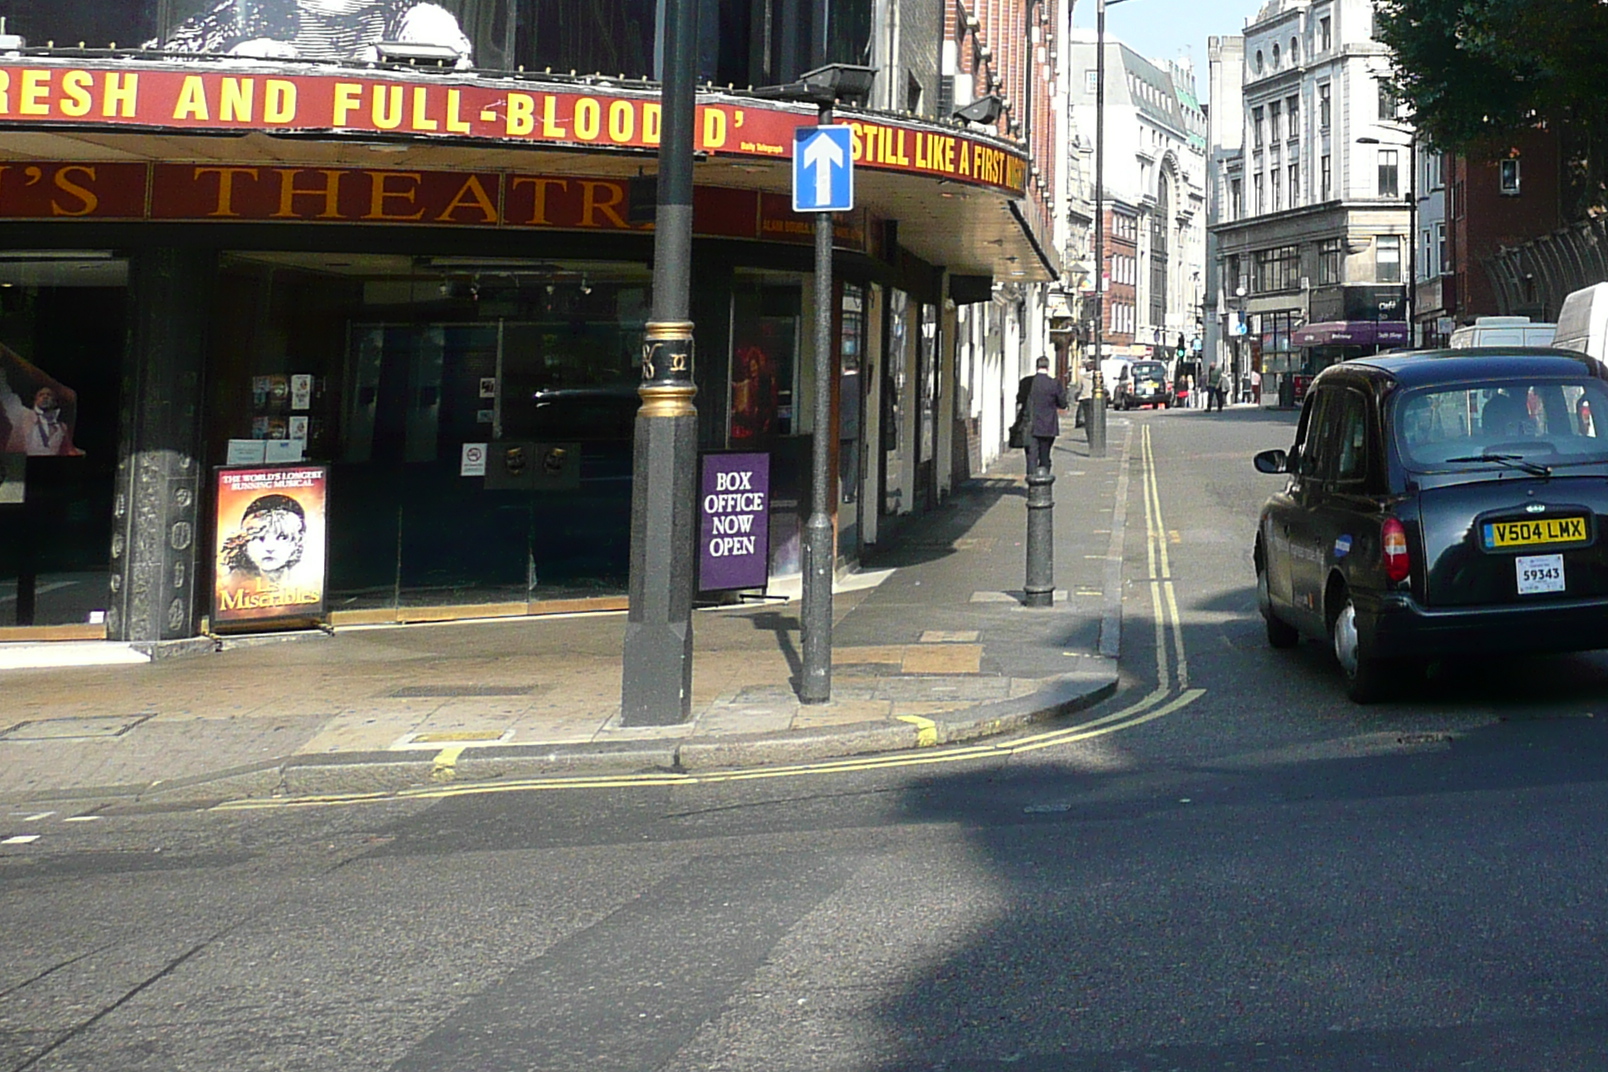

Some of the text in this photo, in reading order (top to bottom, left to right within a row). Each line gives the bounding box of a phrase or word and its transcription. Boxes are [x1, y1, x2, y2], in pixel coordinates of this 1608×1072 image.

[173, 74, 298, 125] AND
[332, 82, 744, 148] FULL-BLOODD'
[756, 142, 784, 154] Telegraph
[915, 132, 955, 173] LIKE
[958, 141, 970, 175] A
[973, 145, 1005, 185] FIRST
[193, 167, 657, 229] THEATR
[716, 471, 753, 491] BOX
[704, 492, 764, 514] OFFICE
[712, 514, 754, 535] NOW
[1496, 519, 1583, 543] V504 LMX
[709, 536, 756, 557] OPEN
[1523, 568, 1560, 582] 59343
